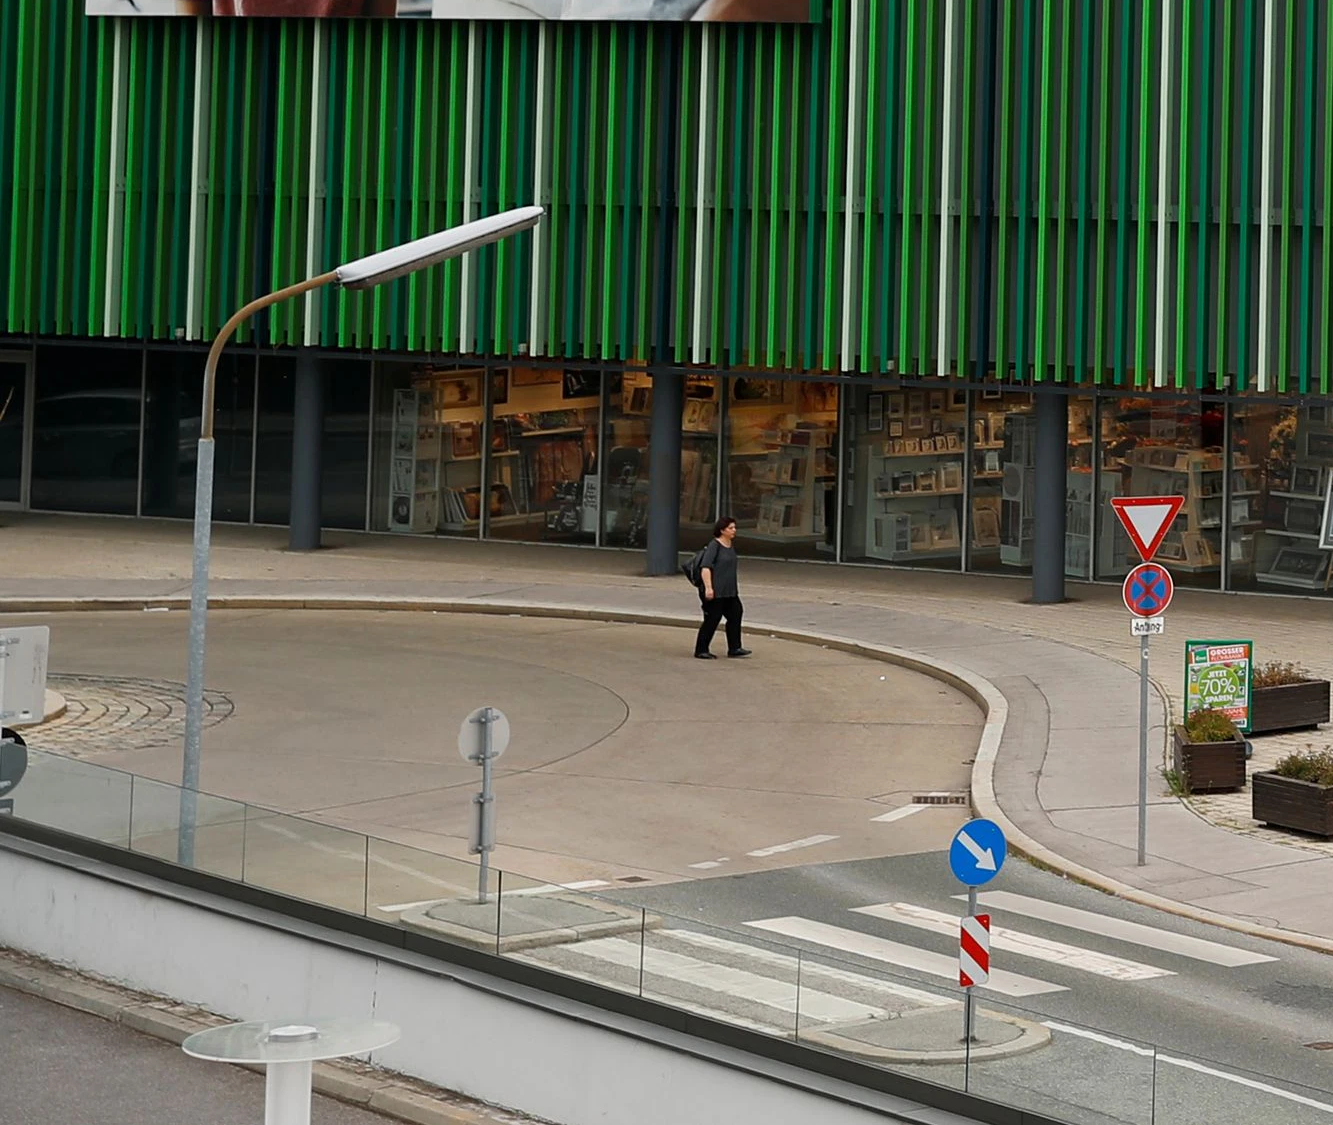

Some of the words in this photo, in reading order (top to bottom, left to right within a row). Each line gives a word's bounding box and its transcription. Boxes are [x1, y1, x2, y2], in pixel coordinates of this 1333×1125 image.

[1210, 647, 1244, 655] GROSSER
[1208, 670, 1227, 678] JETZT
[1200, 678, 1236, 695] -70%
[1205, 695, 1233, 703] SPAREN
